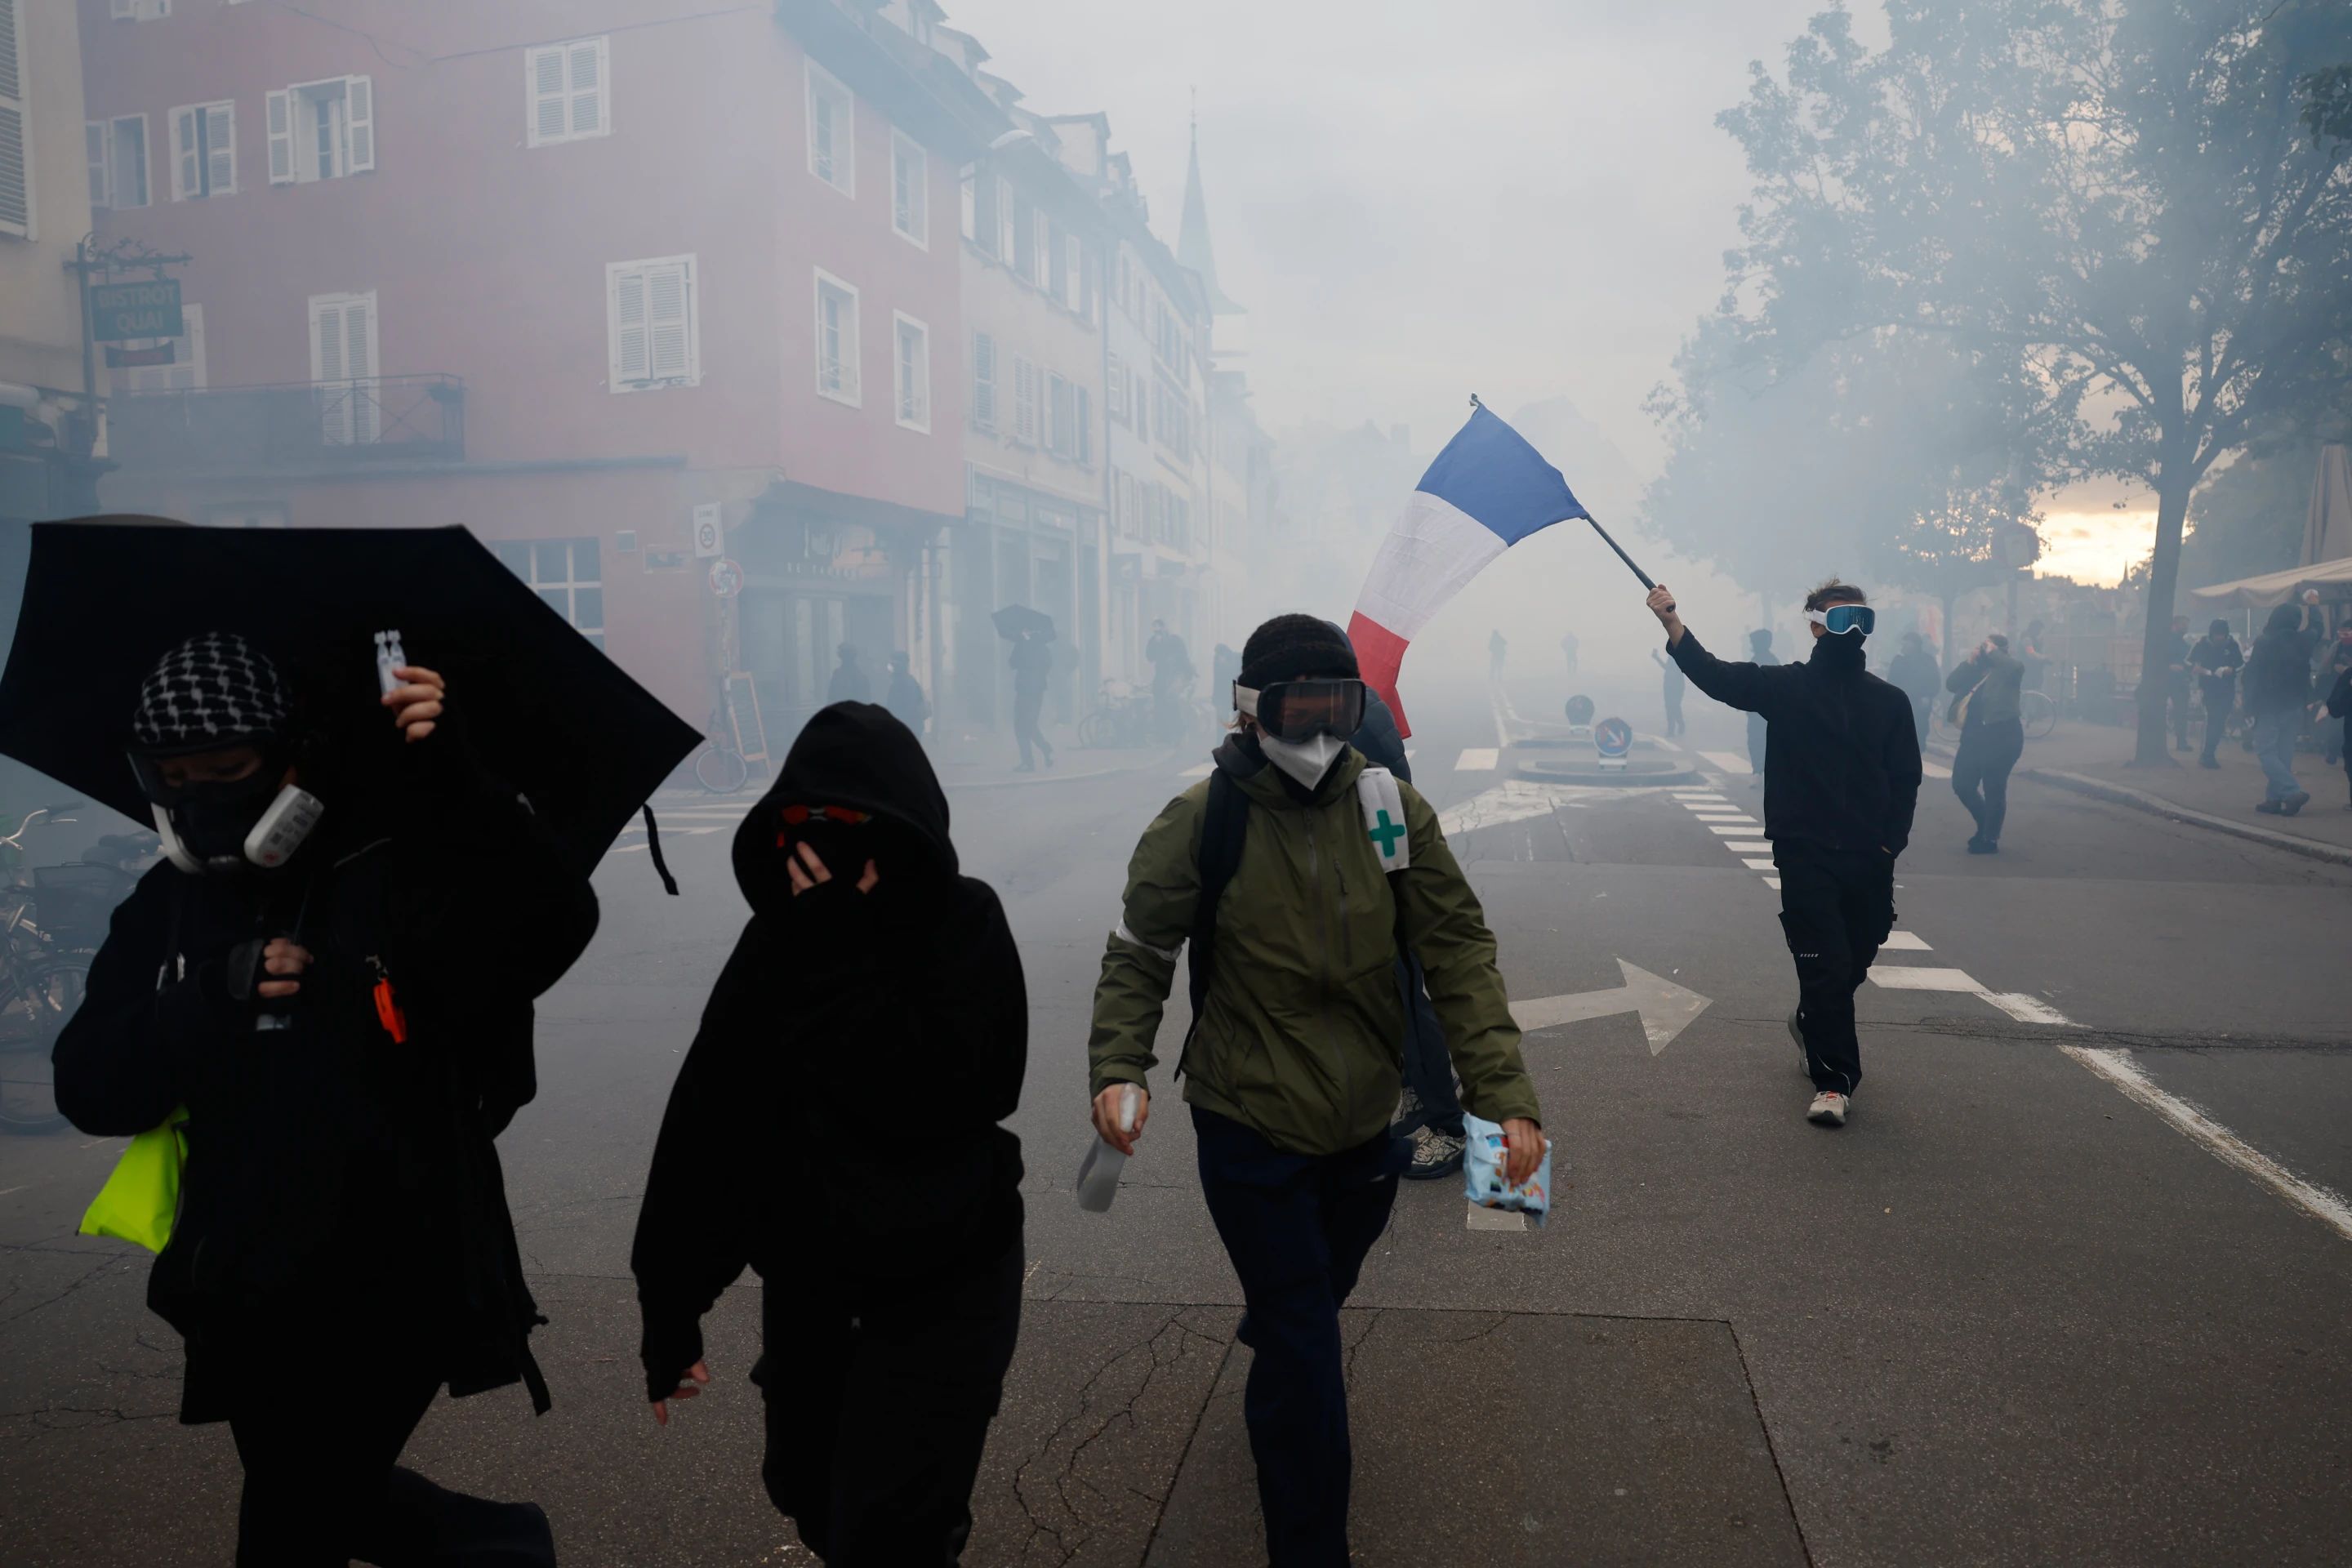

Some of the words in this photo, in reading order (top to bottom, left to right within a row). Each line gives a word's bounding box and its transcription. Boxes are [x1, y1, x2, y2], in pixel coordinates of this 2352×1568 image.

[98, 285, 176, 308] BISTROT
[117, 311, 163, 334] QUAI
[702, 531, 712, 541] 30
